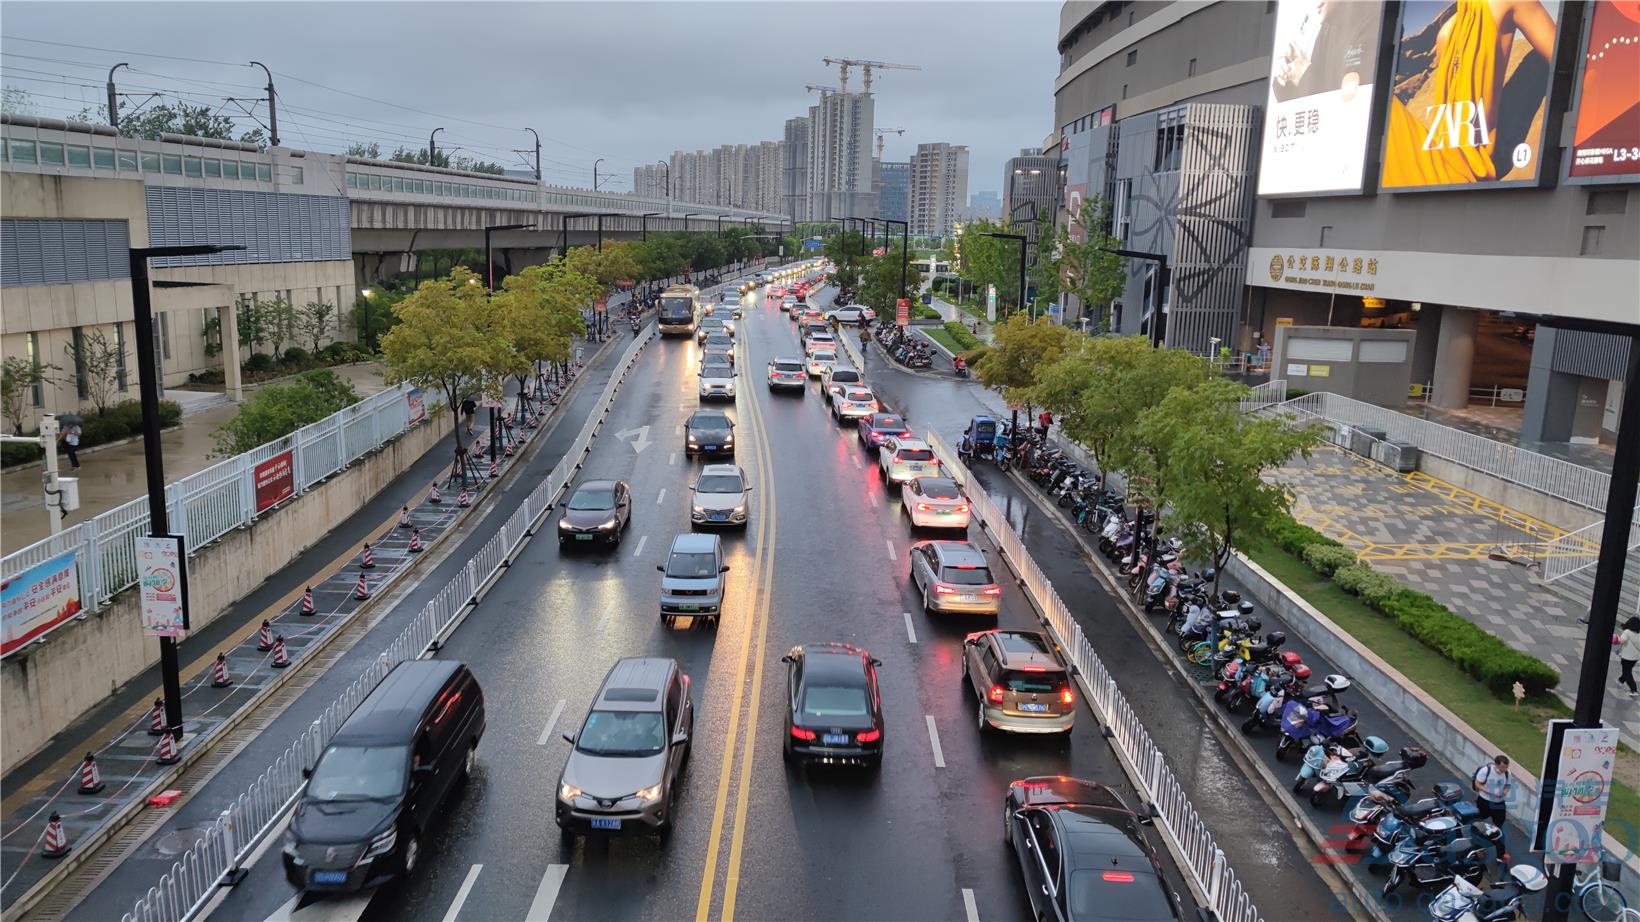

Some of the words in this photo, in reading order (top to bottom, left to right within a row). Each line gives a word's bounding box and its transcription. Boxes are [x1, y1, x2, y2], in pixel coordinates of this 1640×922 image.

[1422, 98, 1492, 151] ZARA
[1516, 149, 1528, 162] L1
[1613, 147, 1640, 162] L3-3
